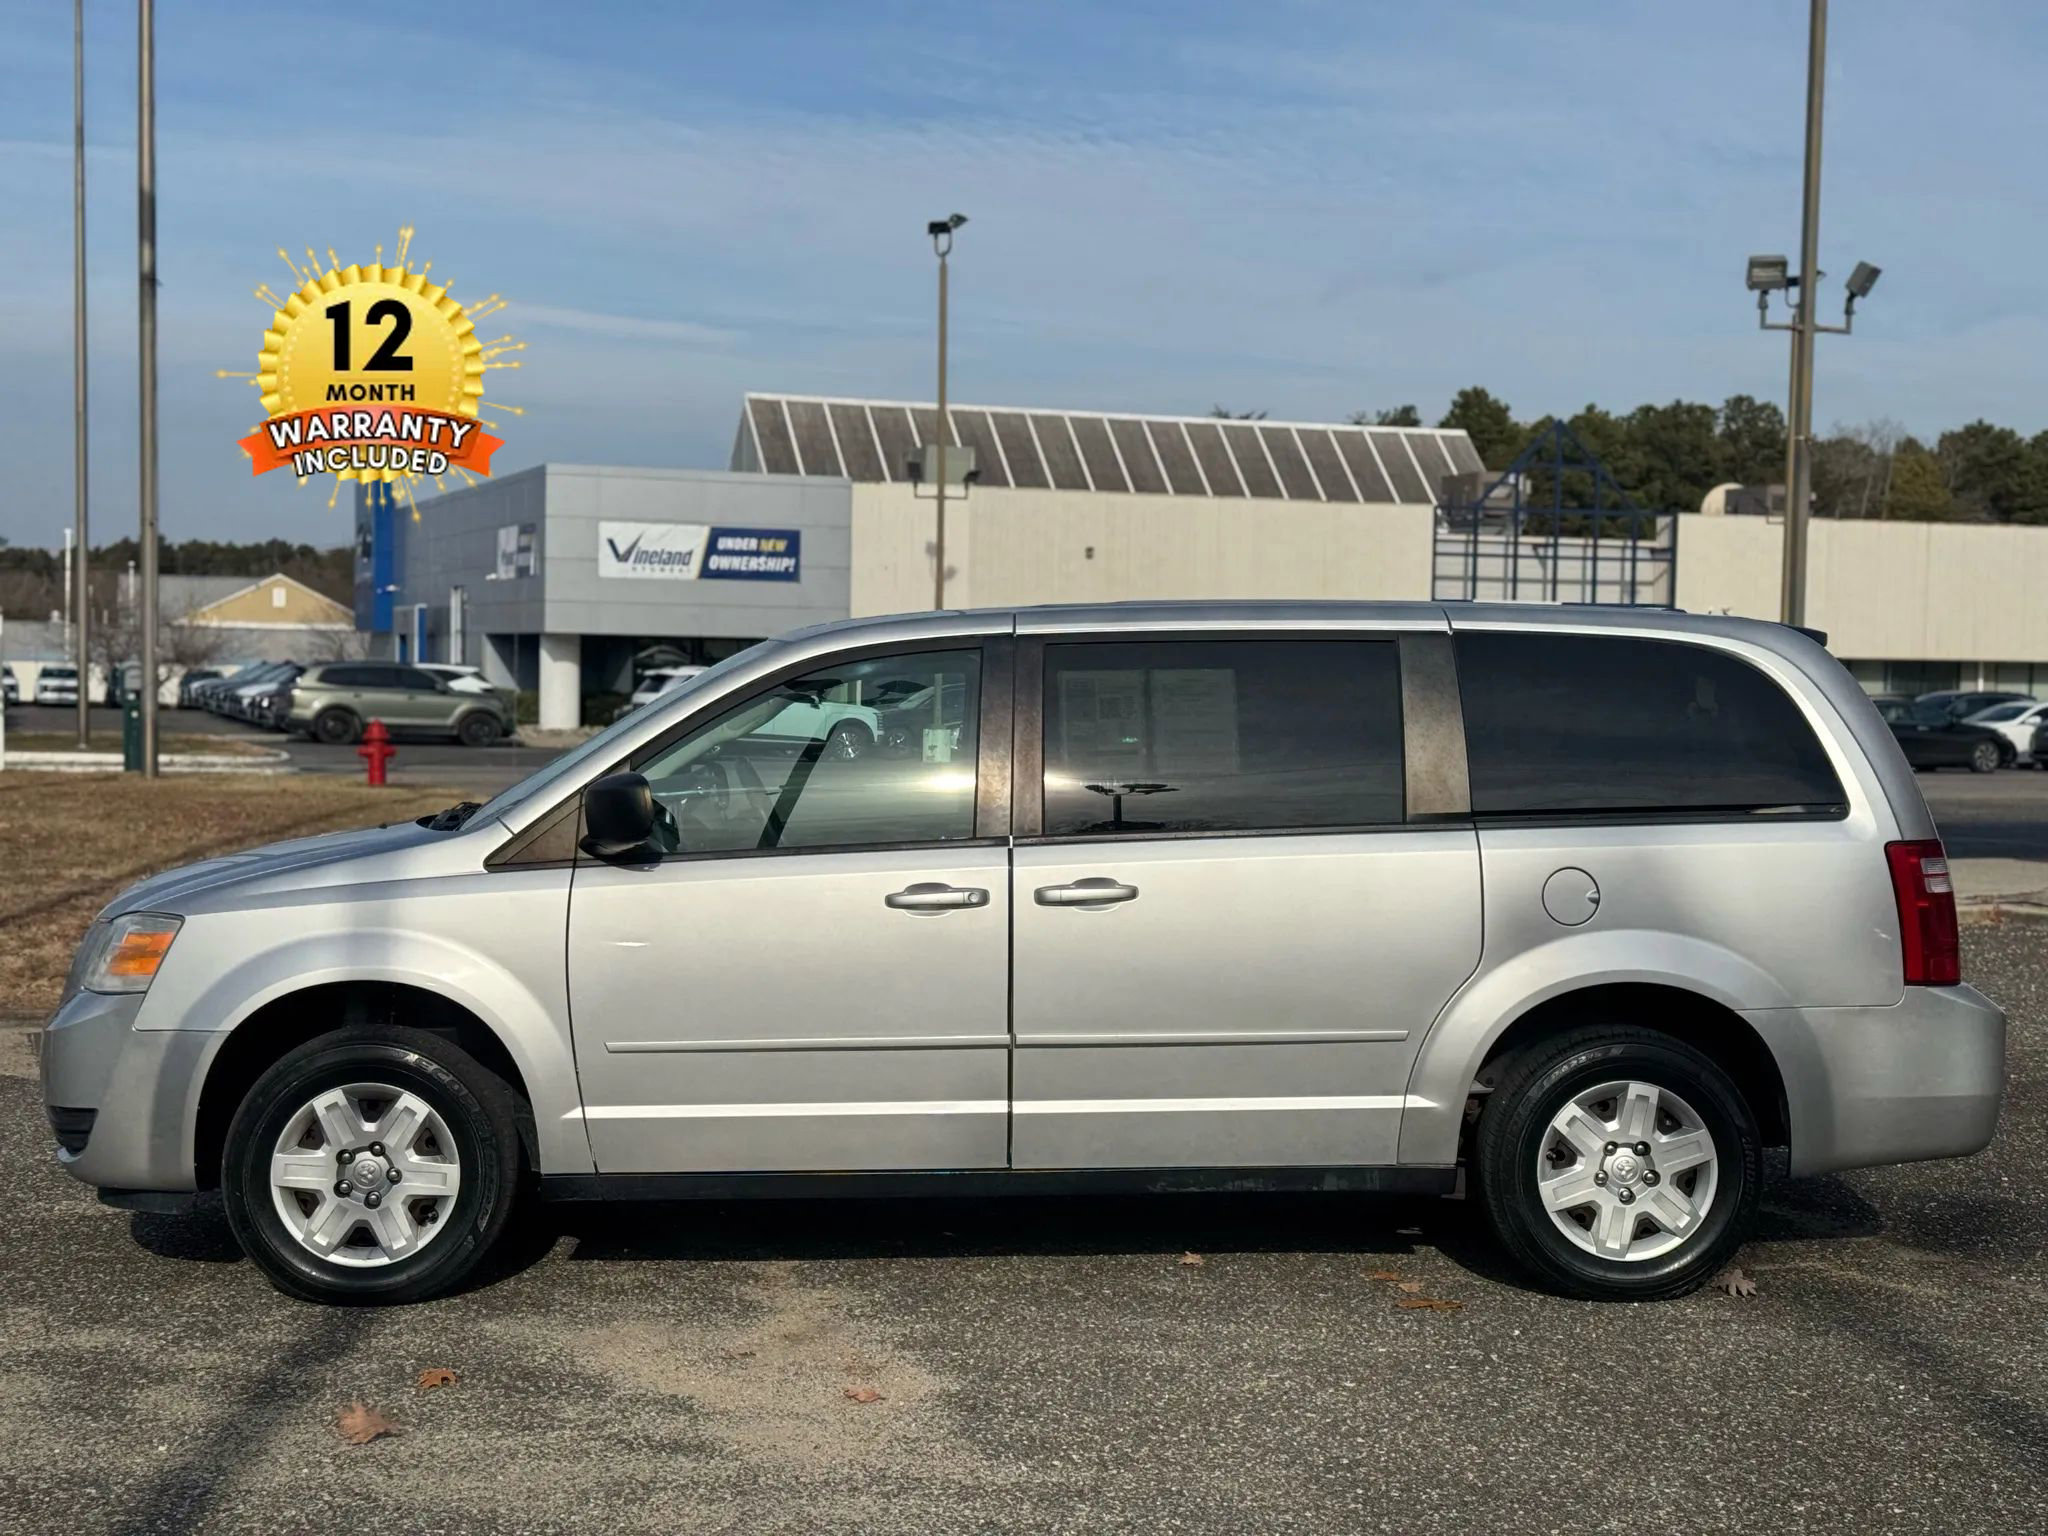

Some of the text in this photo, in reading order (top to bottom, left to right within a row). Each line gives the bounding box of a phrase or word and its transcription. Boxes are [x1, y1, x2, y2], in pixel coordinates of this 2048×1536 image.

[606, 530, 693, 566] Vineland
[716, 536, 788, 552] UNDER NEW
[708, 554, 796, 573] OWNERSHIP!
